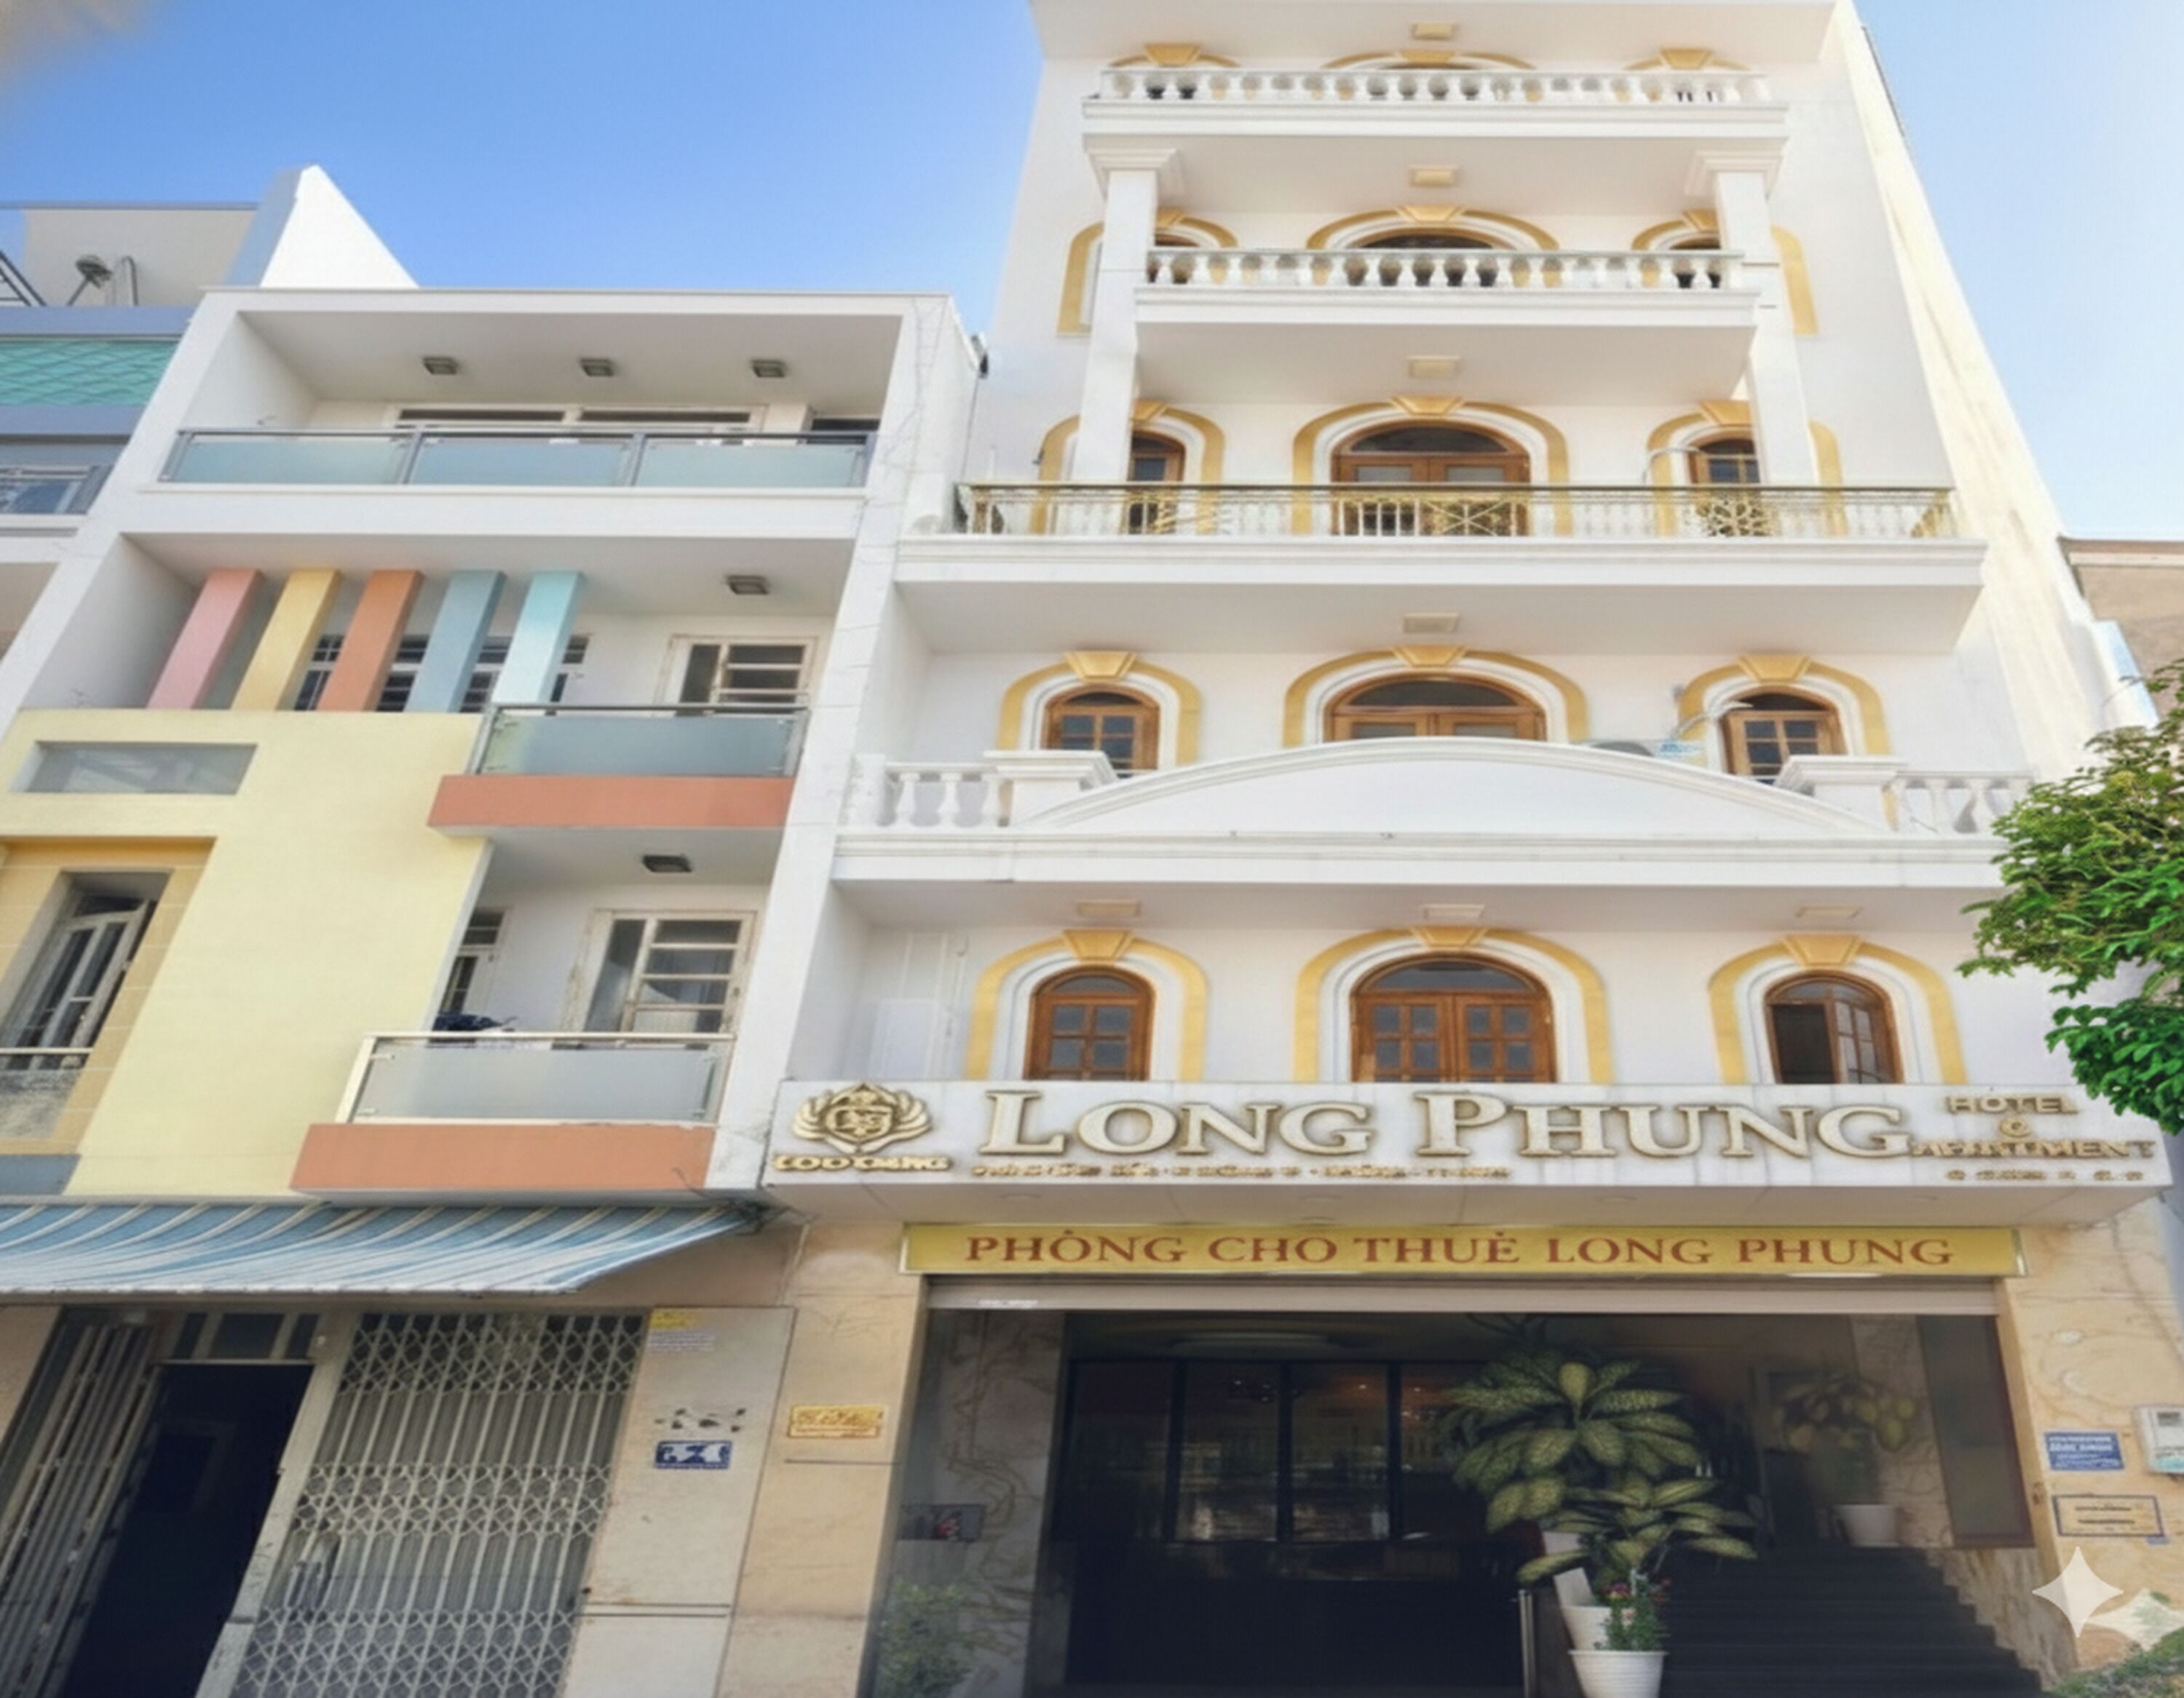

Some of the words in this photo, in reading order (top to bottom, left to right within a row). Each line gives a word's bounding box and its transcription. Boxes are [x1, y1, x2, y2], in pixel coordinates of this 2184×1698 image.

[1945, 1095, 2078, 1115] HOTEL
[978, 1090, 1373, 1157] LONG
[1412, 1091, 1912, 1159] PHUNG
[1208, 1237, 1338, 1263] CHO
[1546, 1238, 1714, 1265] LONG
[1737, 1238, 1954, 1266] PHUNG
